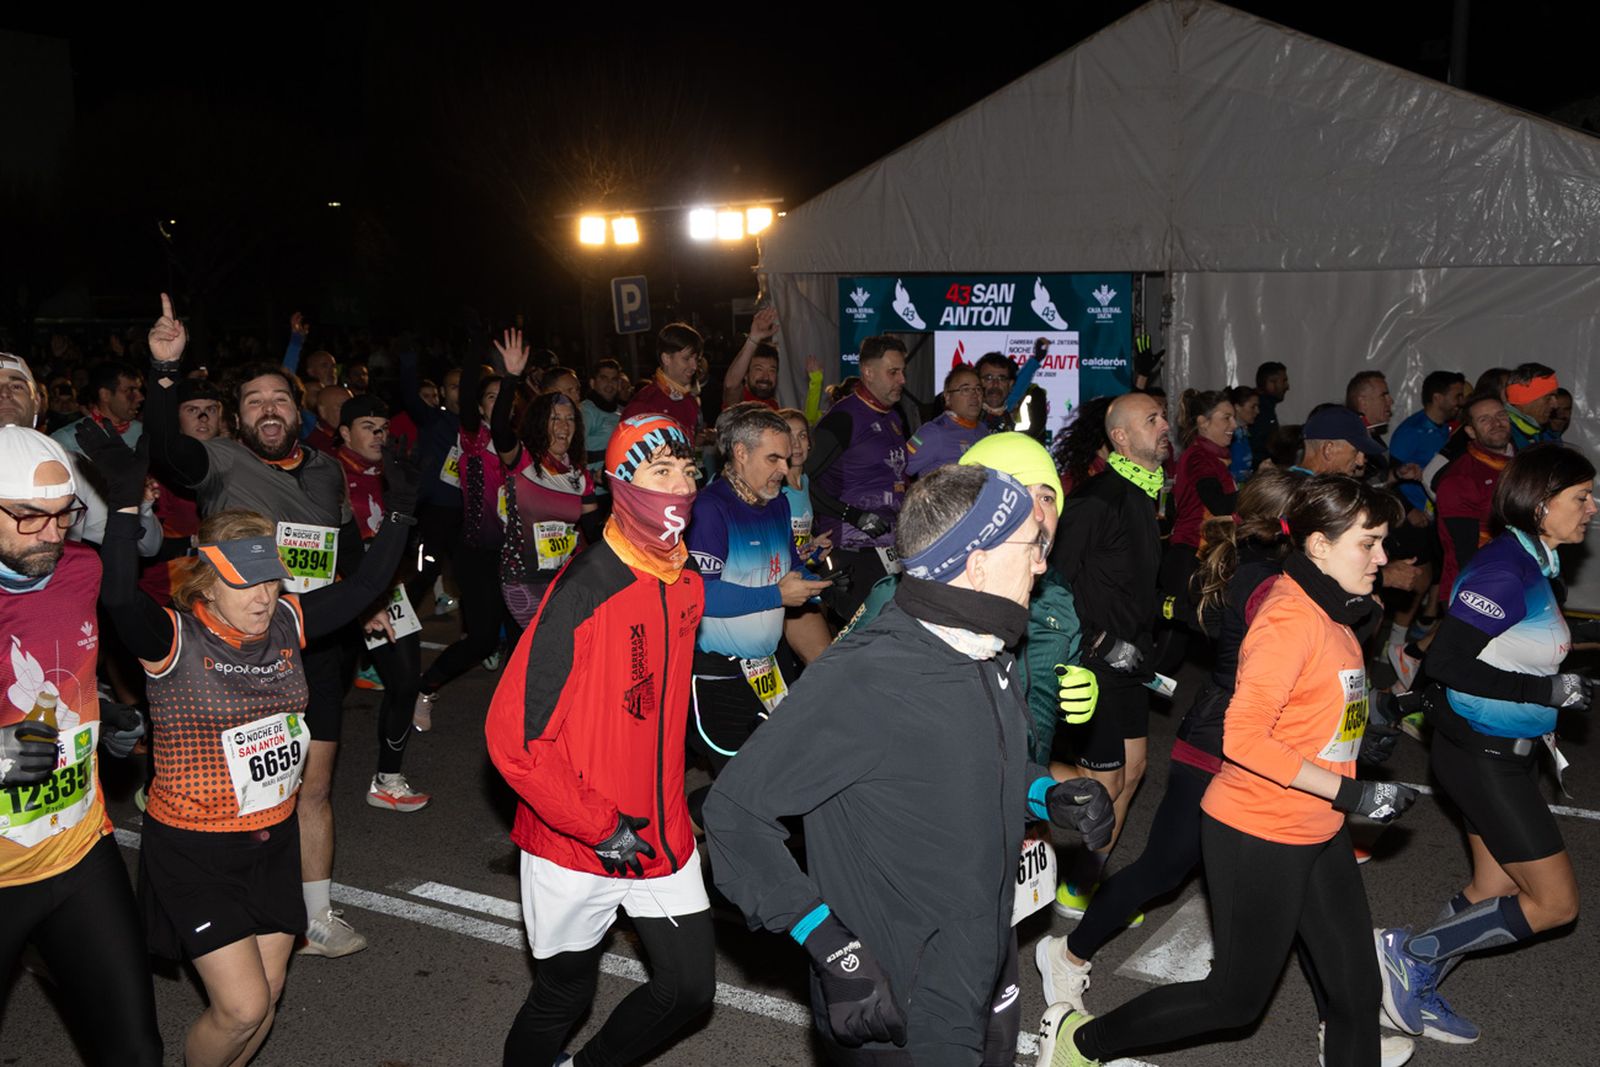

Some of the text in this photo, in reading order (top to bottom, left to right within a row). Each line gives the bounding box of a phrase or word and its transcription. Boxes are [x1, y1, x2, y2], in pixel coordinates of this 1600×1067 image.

[621, 284, 641, 326] P
[946, 283, 1015, 305] 43 SAN
[903, 307, 915, 320] 43
[940, 301, 1011, 326] ANTÓN
[1042, 307, 1056, 321] 43
[1082, 357, 1127, 366] calderón
[292, 532, 312, 540] NOCHE
[287, 548, 328, 571] 3394
[1460, 592, 1502, 618] STAND
[630, 624, 645, 640] XI
[246, 727, 272, 743] NOCHE
[274, 723, 284, 734] DE
[239, 744, 257, 758] SAN
[248, 740, 301, 782] 6659
[5, 761, 88, 814] 12335
[1017, 842, 1048, 885] 6718
